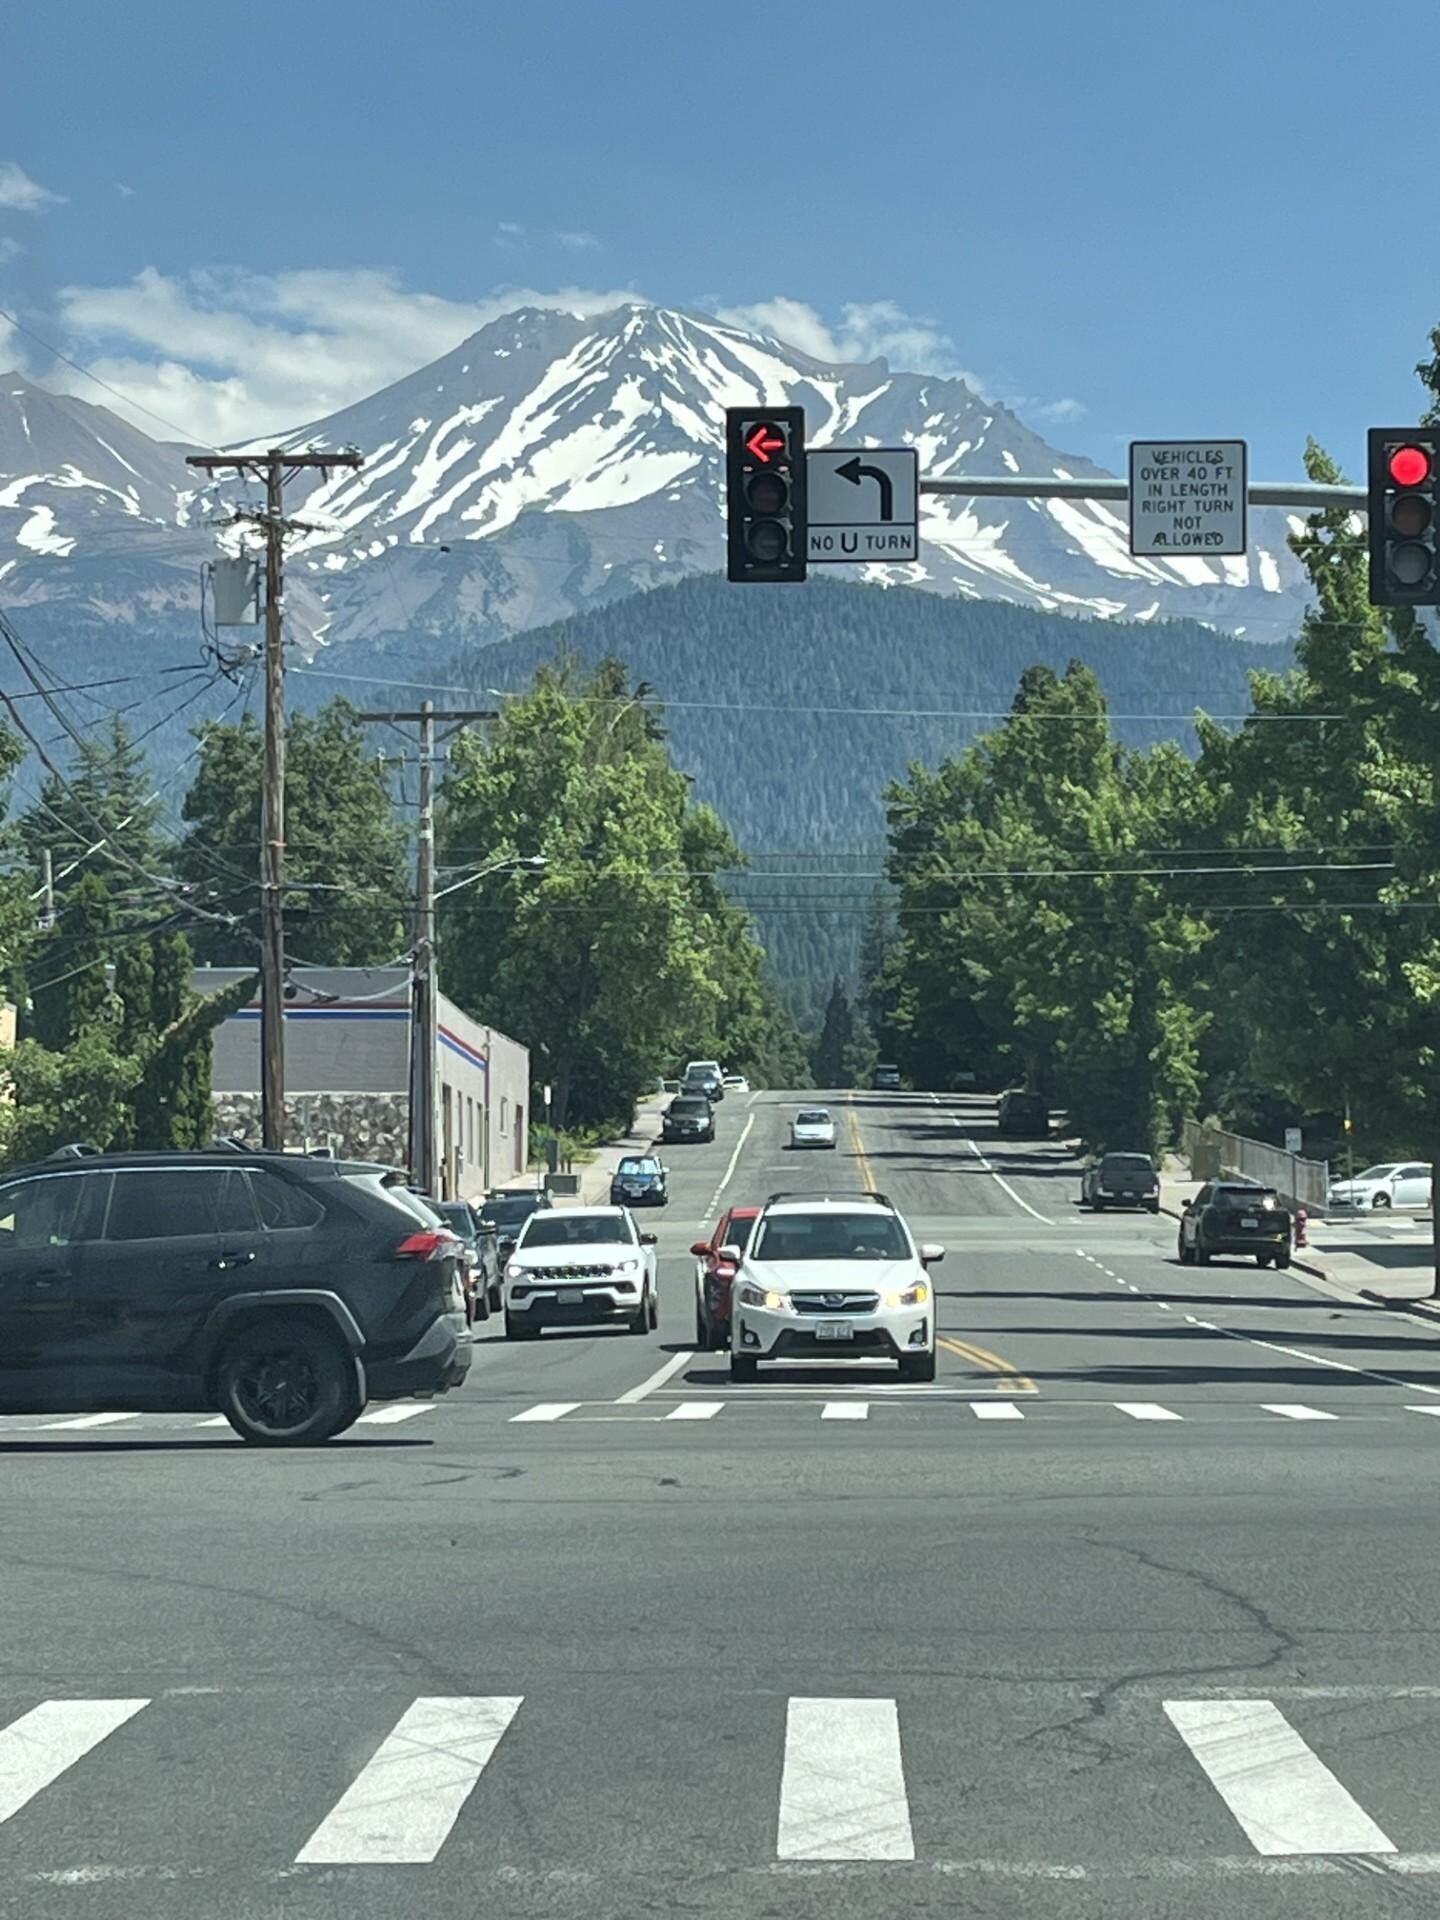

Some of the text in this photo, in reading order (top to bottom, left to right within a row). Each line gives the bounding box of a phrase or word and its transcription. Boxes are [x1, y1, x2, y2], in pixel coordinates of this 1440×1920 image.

[1152, 450, 1224, 465] VEHICLES
[1141, 466, 1233, 481] OVER 40 FT
[1148, 483, 1228, 496] IN LENGTH
[1142, 500, 1234, 513] RIGHT TURN
[1173, 516, 1202, 530] NOT
[811, 532, 911, 553] NO U TURN
[1152, 532, 1224, 546] ALLOWED
